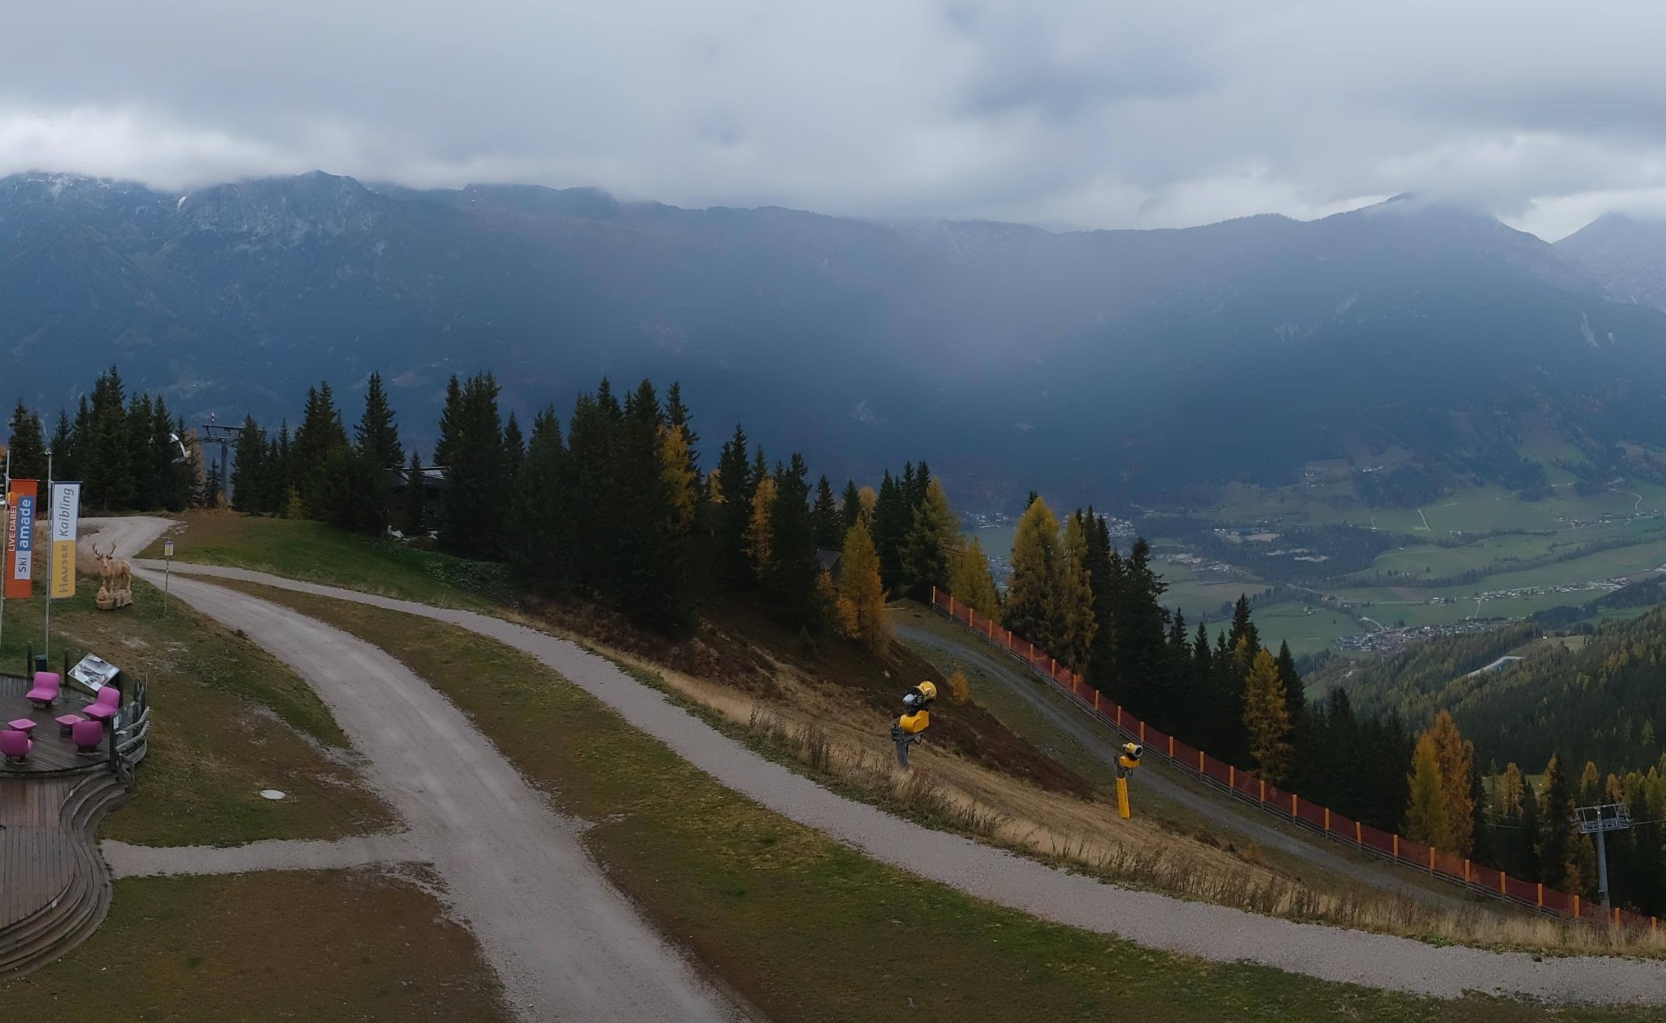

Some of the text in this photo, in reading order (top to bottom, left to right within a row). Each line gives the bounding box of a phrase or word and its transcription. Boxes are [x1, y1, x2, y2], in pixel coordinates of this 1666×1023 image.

[8, 505, 18, 552] LIVE DABEI
[18, 498, 32, 573] Ski amade
[59, 487, 75, 594] HAUSER Kaibling
